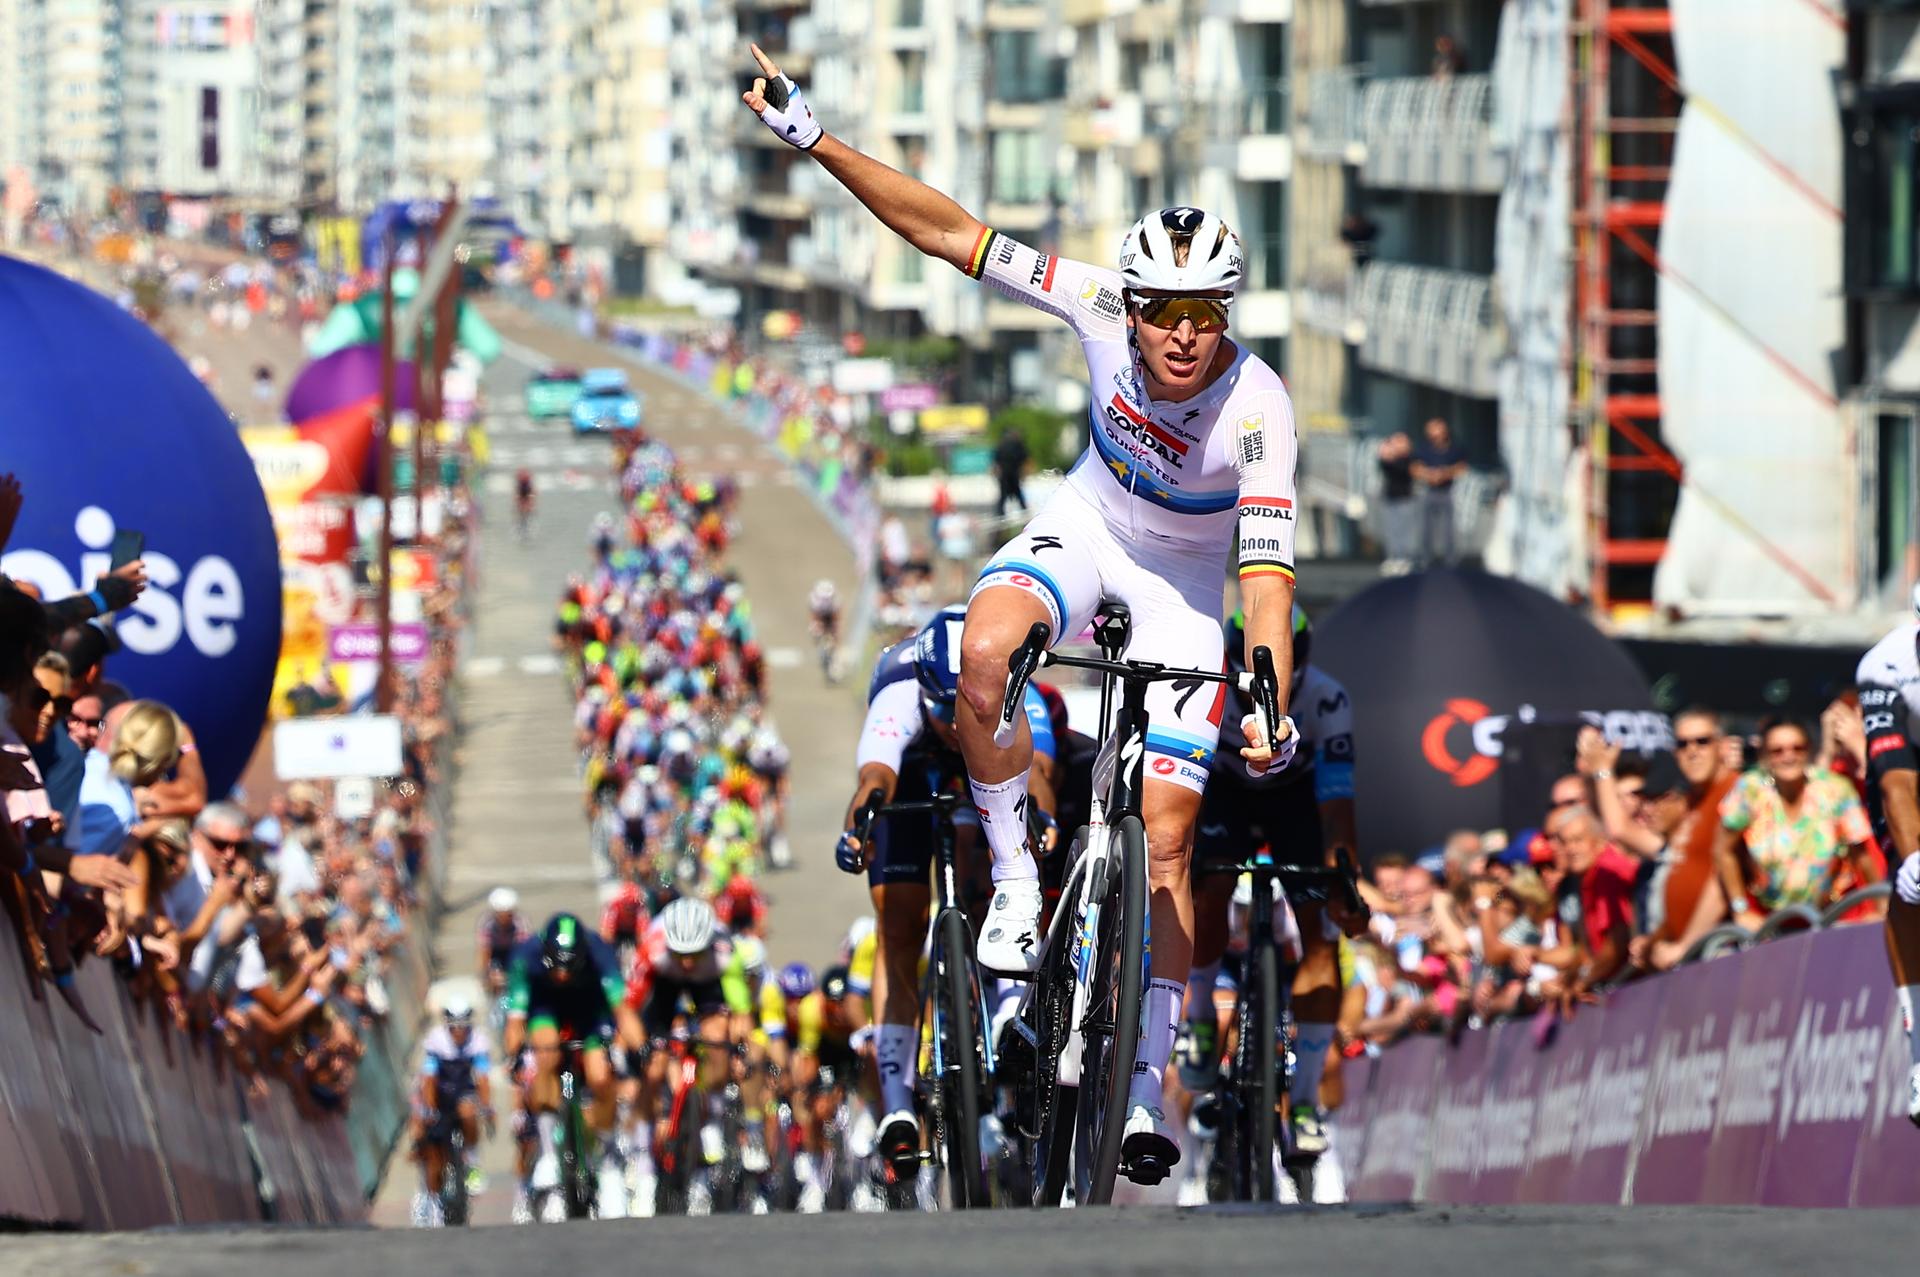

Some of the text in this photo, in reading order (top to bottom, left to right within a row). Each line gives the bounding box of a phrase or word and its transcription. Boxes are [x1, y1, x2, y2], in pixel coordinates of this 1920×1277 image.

[1093, 295, 1122, 316] JOGGER
[1097, 287, 1125, 307] SAFETY
[1106, 405, 1183, 470] SOUDAL
[1160, 417, 1201, 444] NAPOLEON
[1252, 430, 1263, 461] SAFETY
